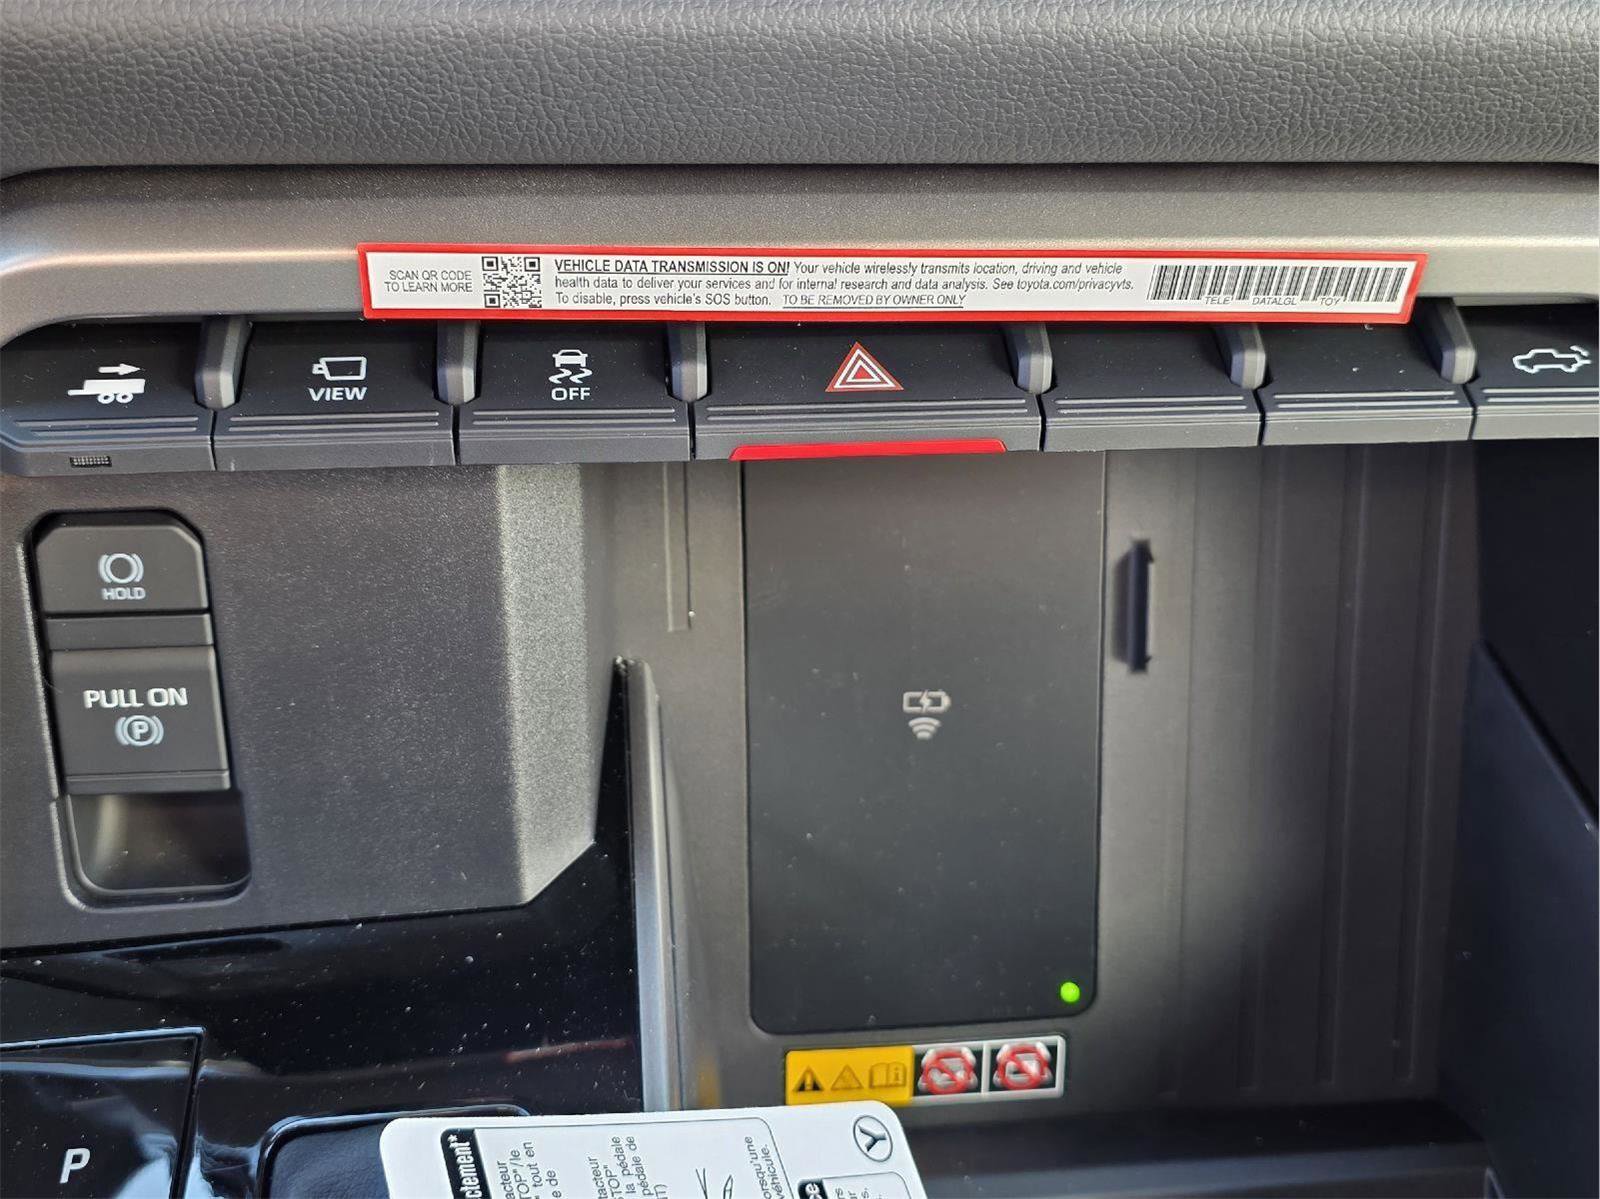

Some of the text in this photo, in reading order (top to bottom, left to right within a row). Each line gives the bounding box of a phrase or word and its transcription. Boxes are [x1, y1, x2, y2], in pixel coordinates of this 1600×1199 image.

[389, 270, 472, 281] SCAN QR CODE
[554, 259, 1123, 277] VEHICLE DATA TRANSMISSION IS ON! Your vehicle wirelessly transmits location, driving and vehicle
[384, 282, 473, 293] TO LEARN MORE
[554, 276, 1134, 293] health data to deliver your services and for internal research and data analysis. See toyota.com/privacyvts.
[555, 292, 967, 307] To disable, press vehicle's SOS button. TO BE REMOVED BY OWNER ONLY
[1204, 297, 1231, 305] TELE
[1319, 297, 1341, 306] TOY
[308, 387, 368, 402] VIEW
[551, 387, 591, 401] OFF
[101, 587, 146, 600] HOLD
[83, 687, 188, 709] PULL ON
[523, 1141, 535, 1158] en
[60, 1148, 91, 1184] P
[611, 1136, 637, 1194] la pédale
[625, 1136, 654, 1196] pédale de
[527, 1163, 543, 1188] tout
[546, 1169, 558, 1187] de
